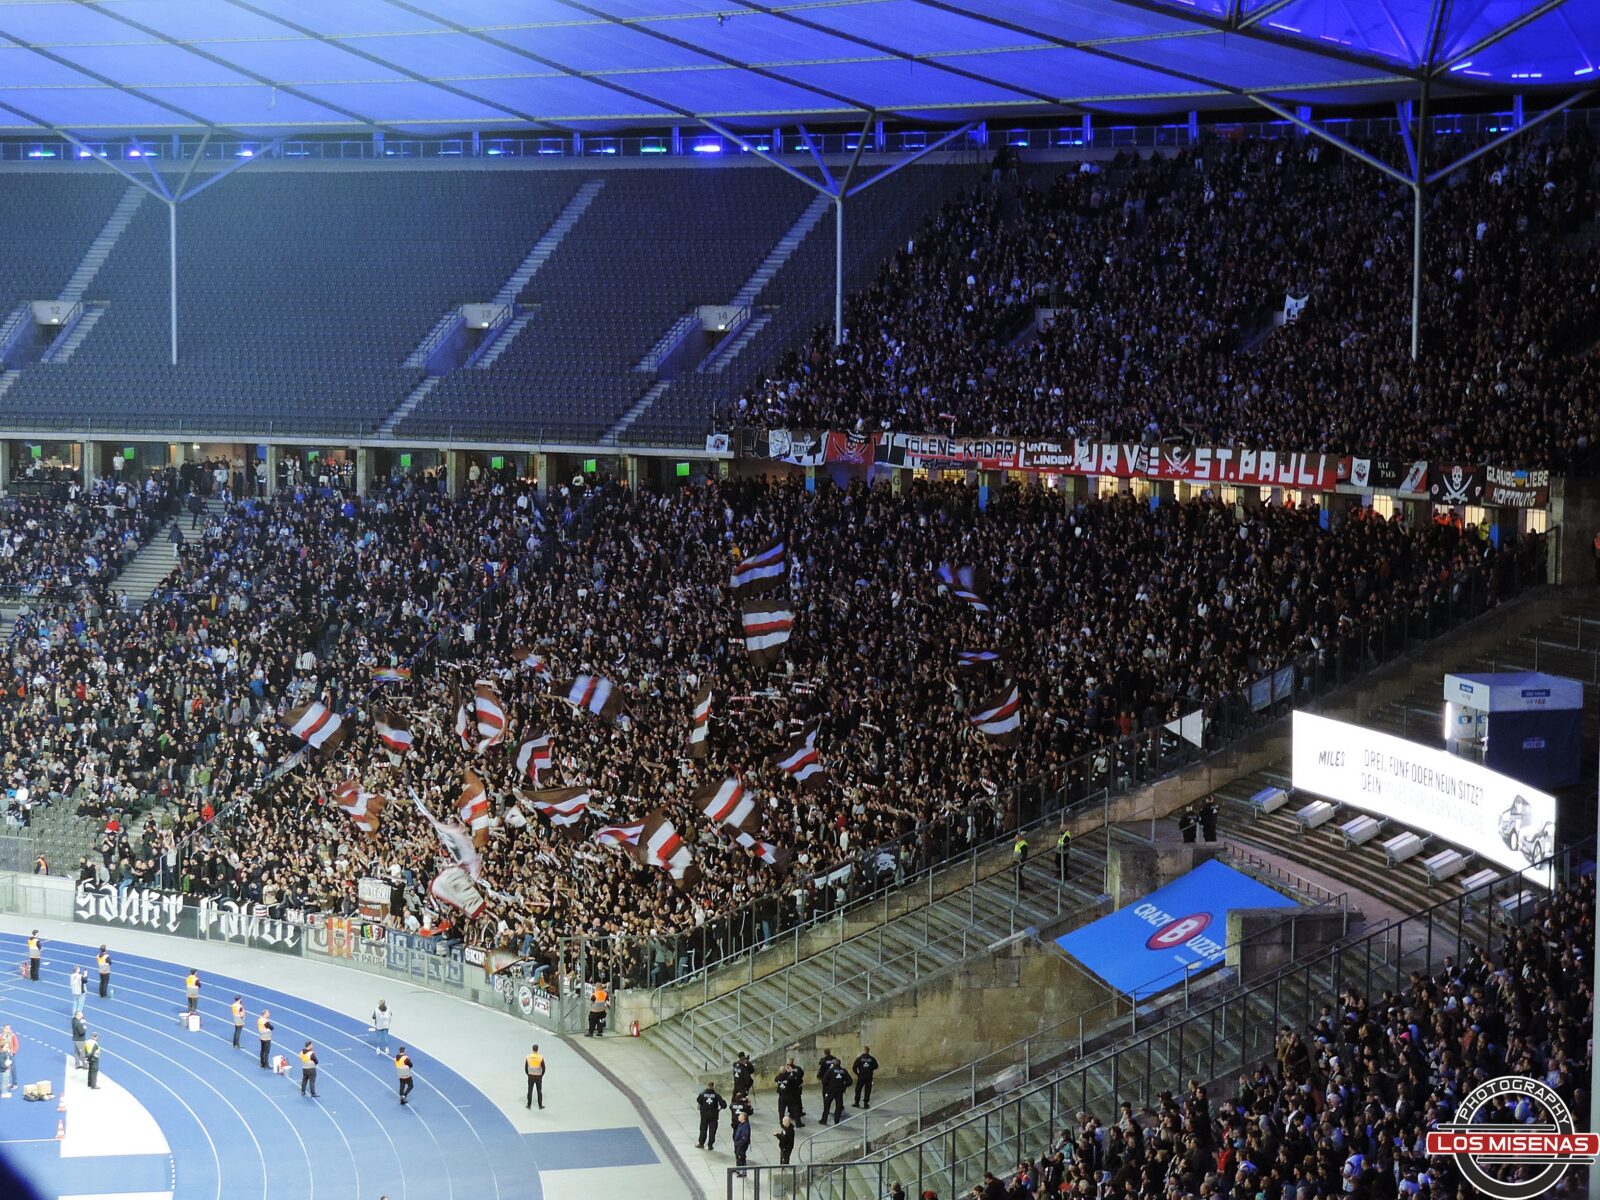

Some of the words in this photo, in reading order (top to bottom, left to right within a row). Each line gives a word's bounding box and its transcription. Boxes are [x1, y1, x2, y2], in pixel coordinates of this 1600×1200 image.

[49, 306, 61, 315] 12
[482, 309, 492, 318] 13
[718, 311, 728, 321] 14
[962, 439, 1015, 460] KADAR
[1026, 442, 1062, 453] UNTER
[1033, 455, 1073, 466] LINDEN
[1486, 465, 1516, 487] GLAUBE
[1524, 469, 1549, 488] LIEBE
[1318, 750, 1346, 768] MILES
[1361, 771, 1381, 795] DEIN
[1411, 763, 1434, 789] ODER
[1435, 771, 1457, 798] NEUN
[1458, 779, 1485, 807] SITZE?
[1133, 902, 1176, 929] CRAZY
